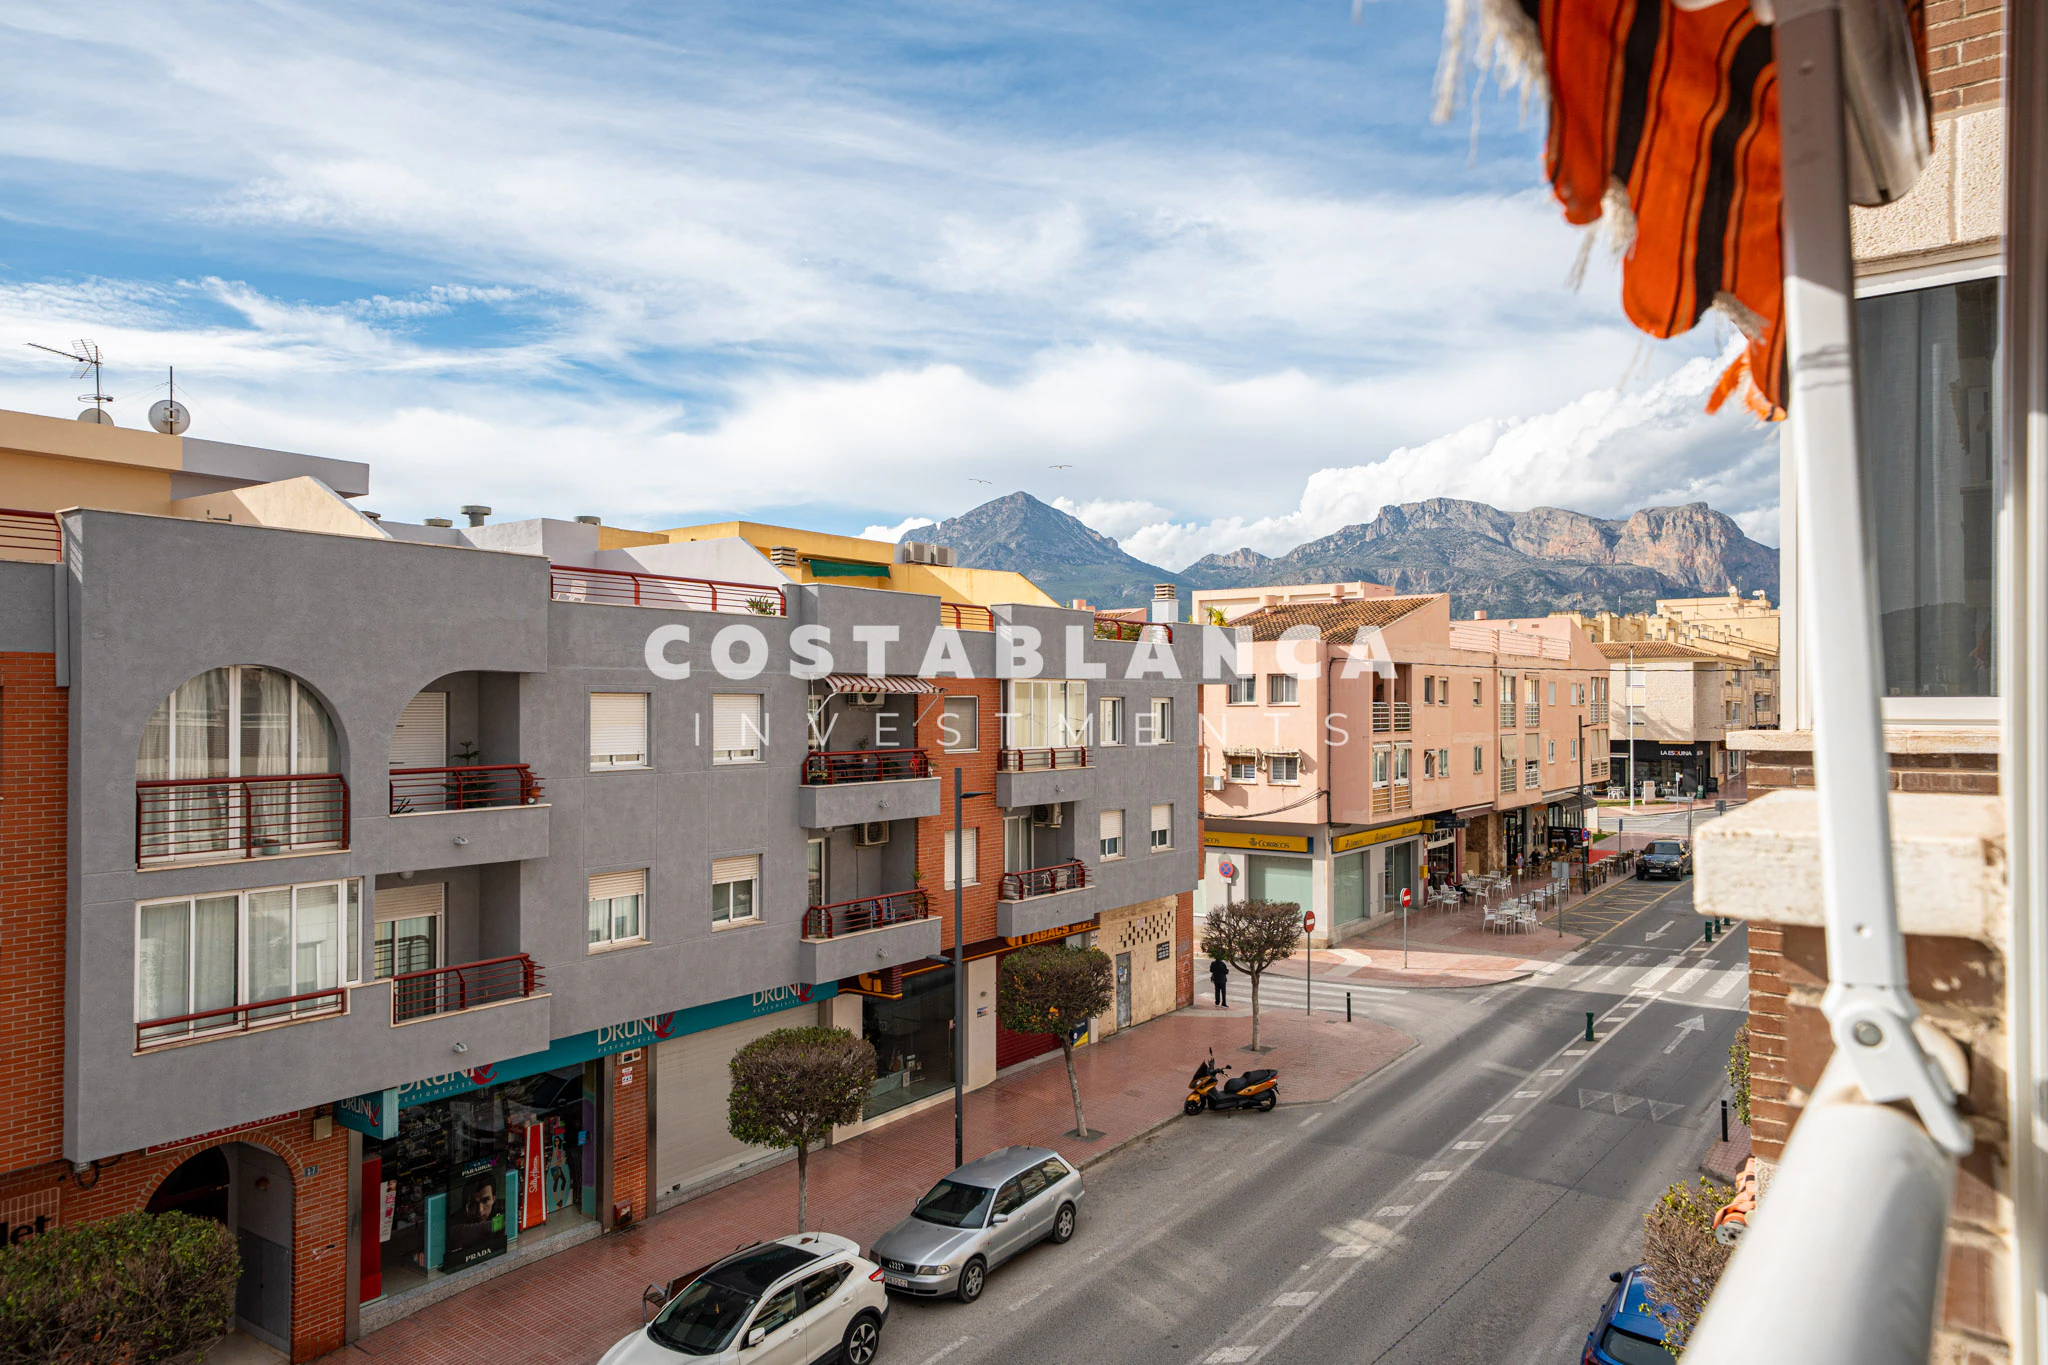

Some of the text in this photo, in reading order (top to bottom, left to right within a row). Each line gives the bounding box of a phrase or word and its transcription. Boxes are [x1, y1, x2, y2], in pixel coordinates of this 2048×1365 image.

[753, 982, 801, 1007] DRUNI
[597, 1015, 658, 1045] DRUNI
[307, 1166, 317, 1177] 17
[465, 1247, 491, 1262] PRADA
